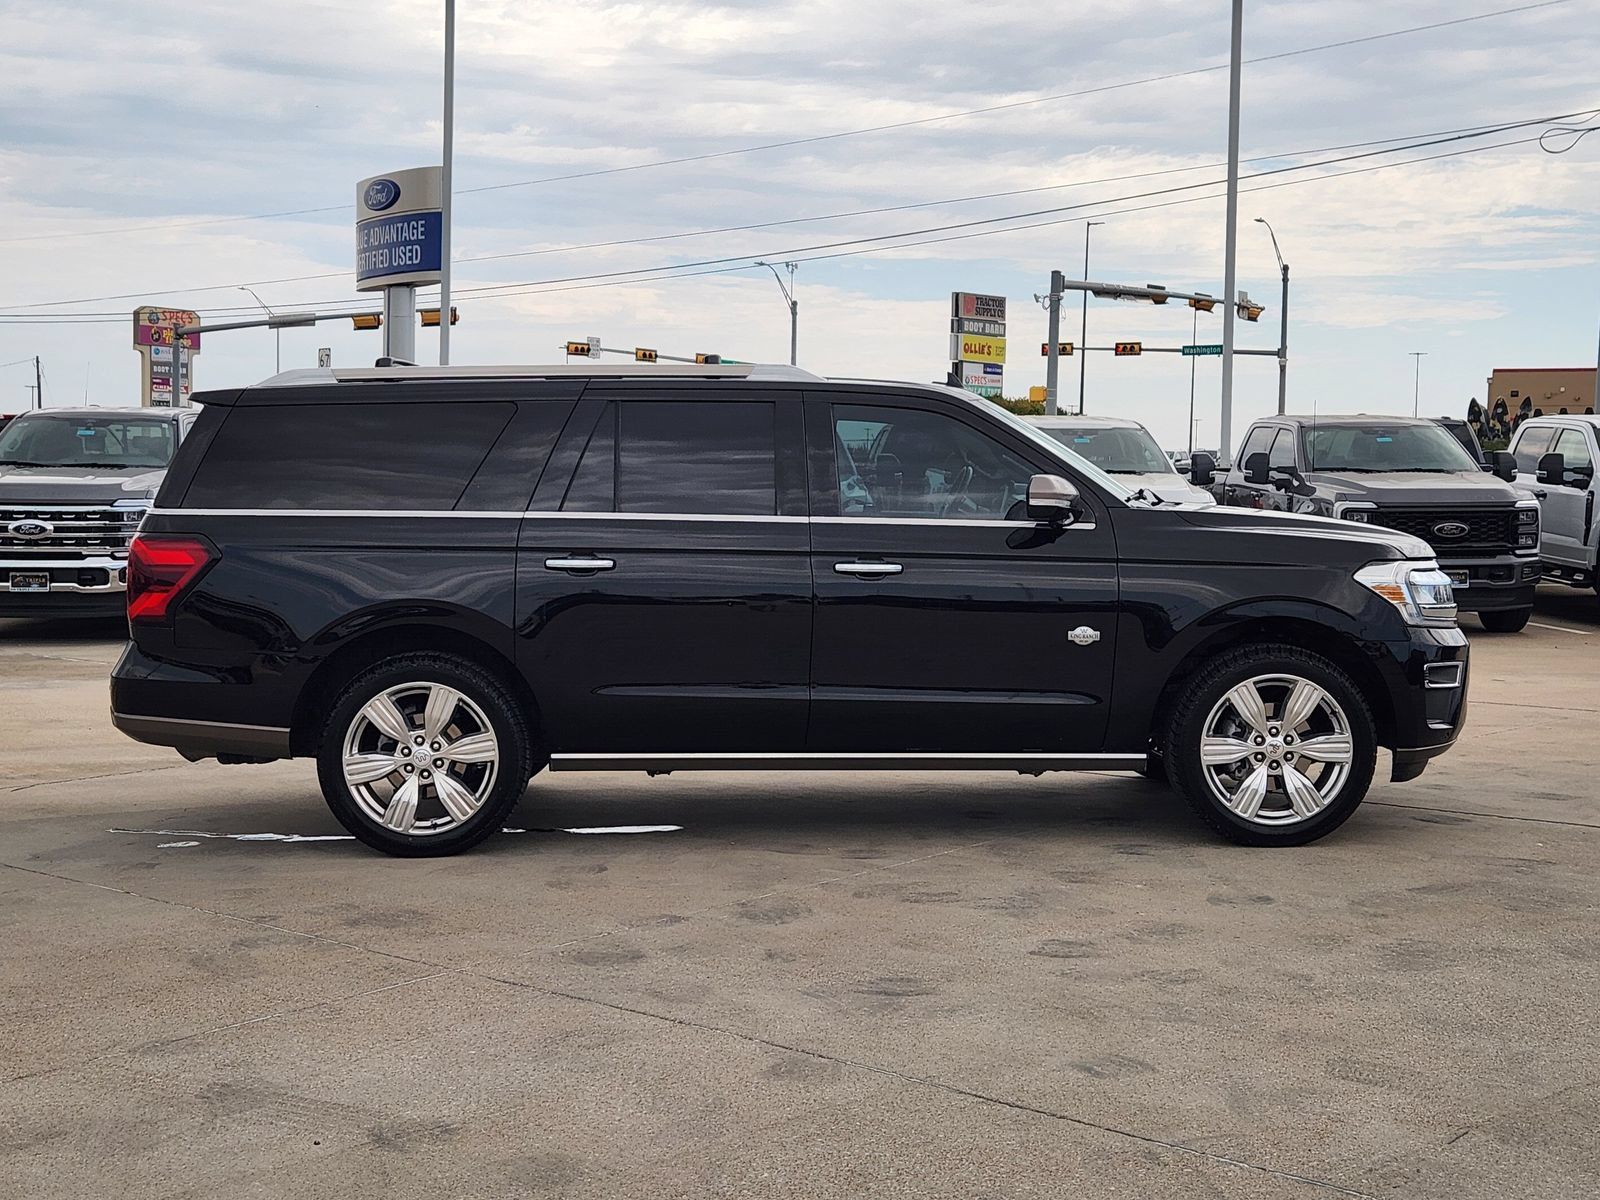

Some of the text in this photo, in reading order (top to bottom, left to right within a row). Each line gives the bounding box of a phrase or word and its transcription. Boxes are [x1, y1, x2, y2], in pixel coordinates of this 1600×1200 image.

[368, 184, 388, 205] Ford
[369, 220, 426, 247] ADVANTAGE
[357, 244, 421, 273] ERTIFIED USED
[975, 296, 1004, 308] TRACTOR
[975, 306, 997, 317] SUPPLY
[964, 321, 1005, 335] BOOT BARN
[963, 342, 992, 356] OLLIE'S
[320, 353, 330, 368] 67
[153, 365, 170, 373] BOOT
[20, 524, 40, 534] Ford
[1442, 525, 1461, 535] Ford
